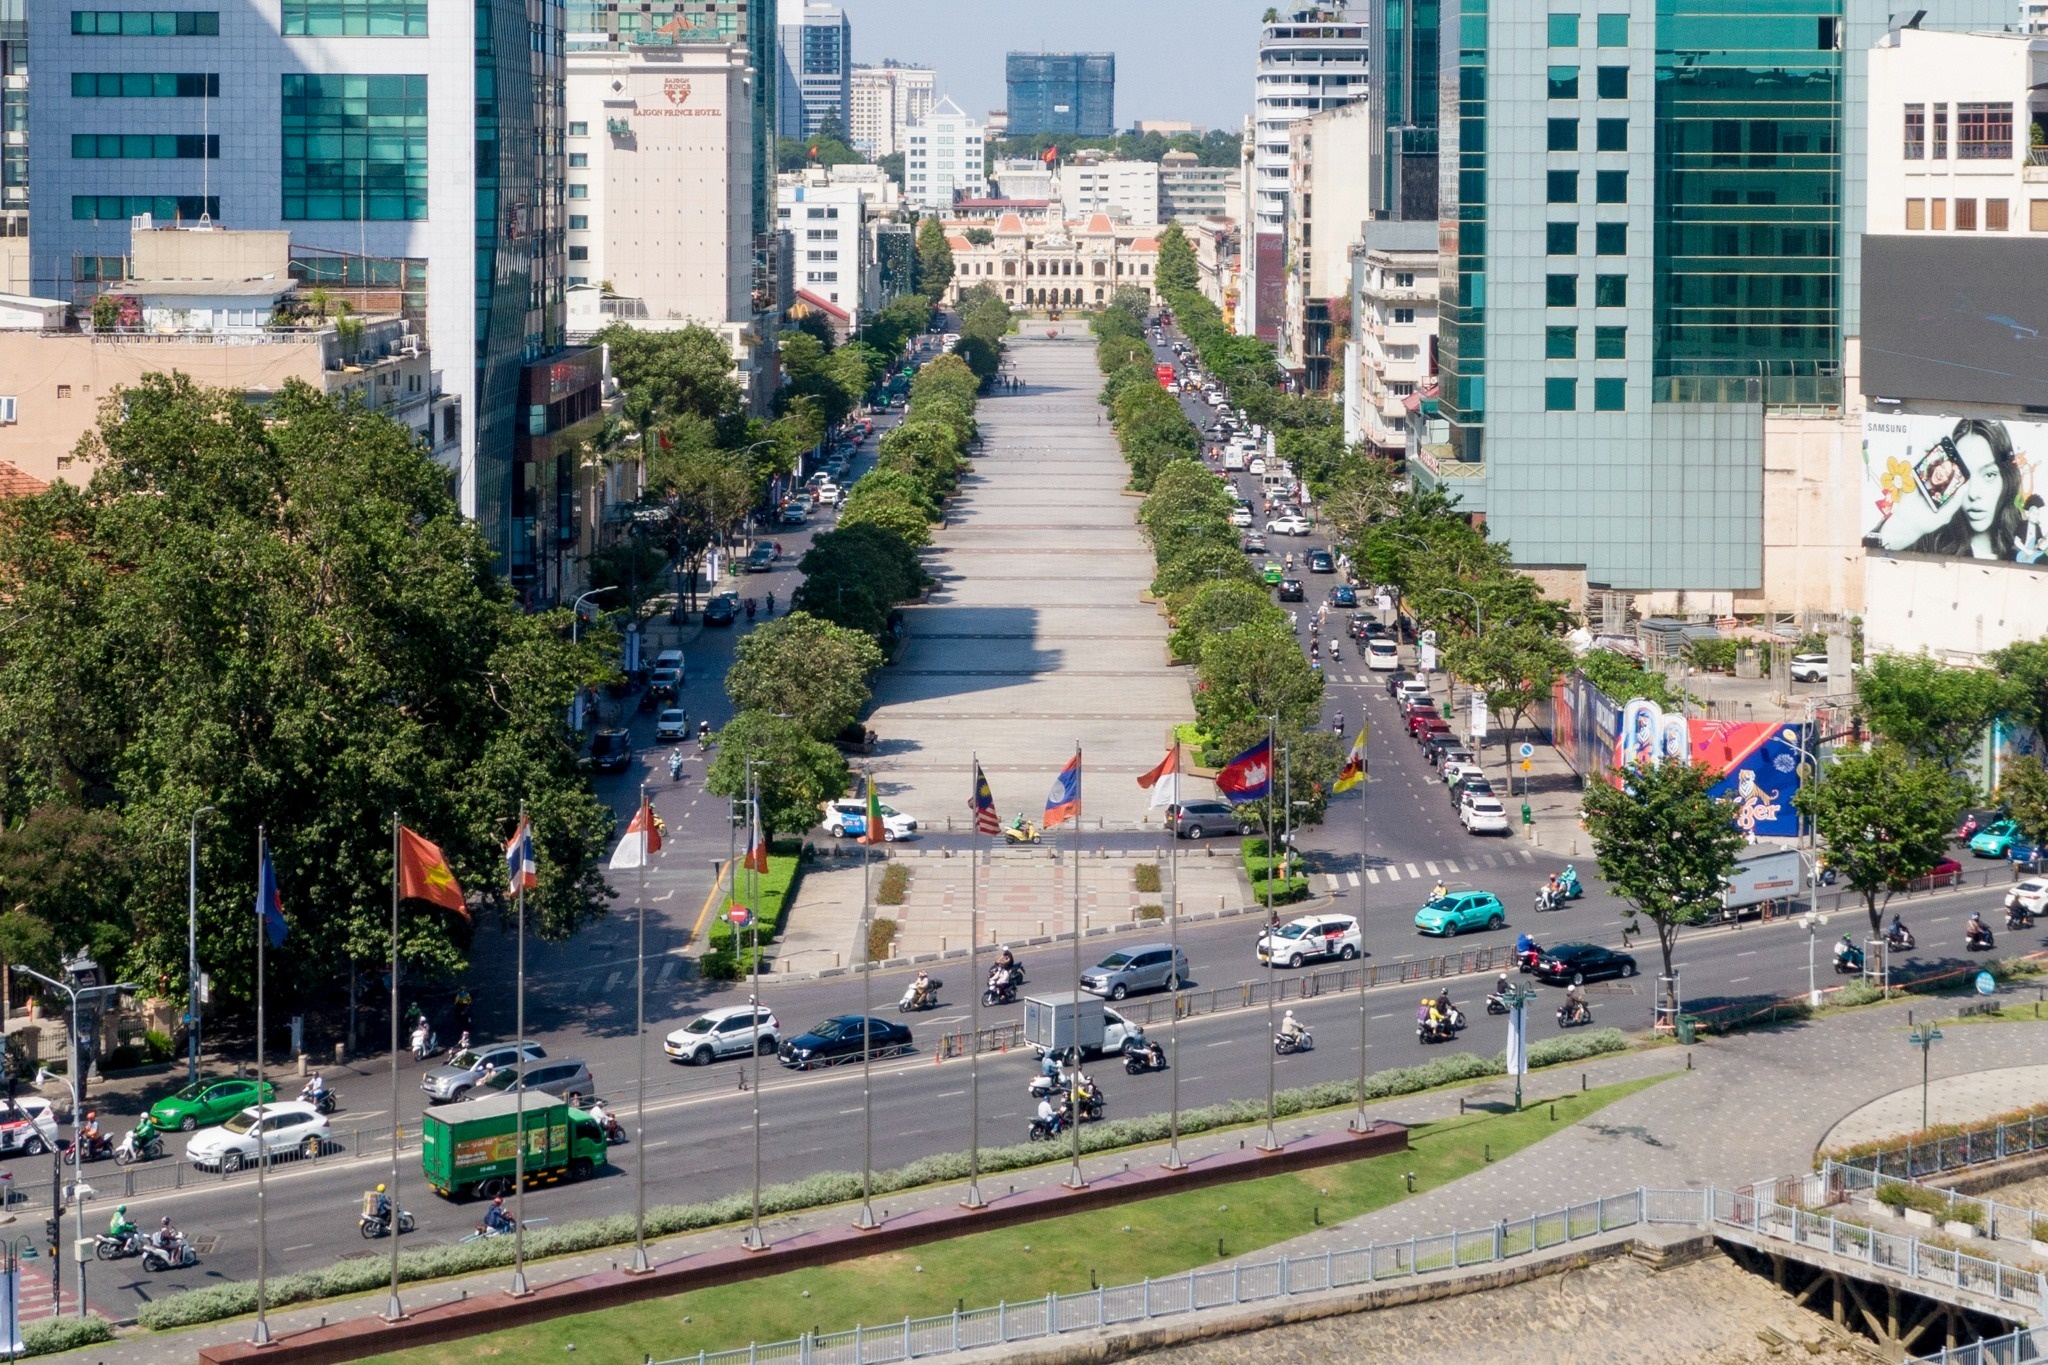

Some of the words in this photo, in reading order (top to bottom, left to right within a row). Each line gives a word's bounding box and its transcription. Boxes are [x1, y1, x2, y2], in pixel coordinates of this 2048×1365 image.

[633, 109, 663, 117] SAIGON
[664, 109, 693, 117] PRINCE
[1867, 423, 1907, 434] SAMSUNG
[1715, 796, 1781, 829] ger
